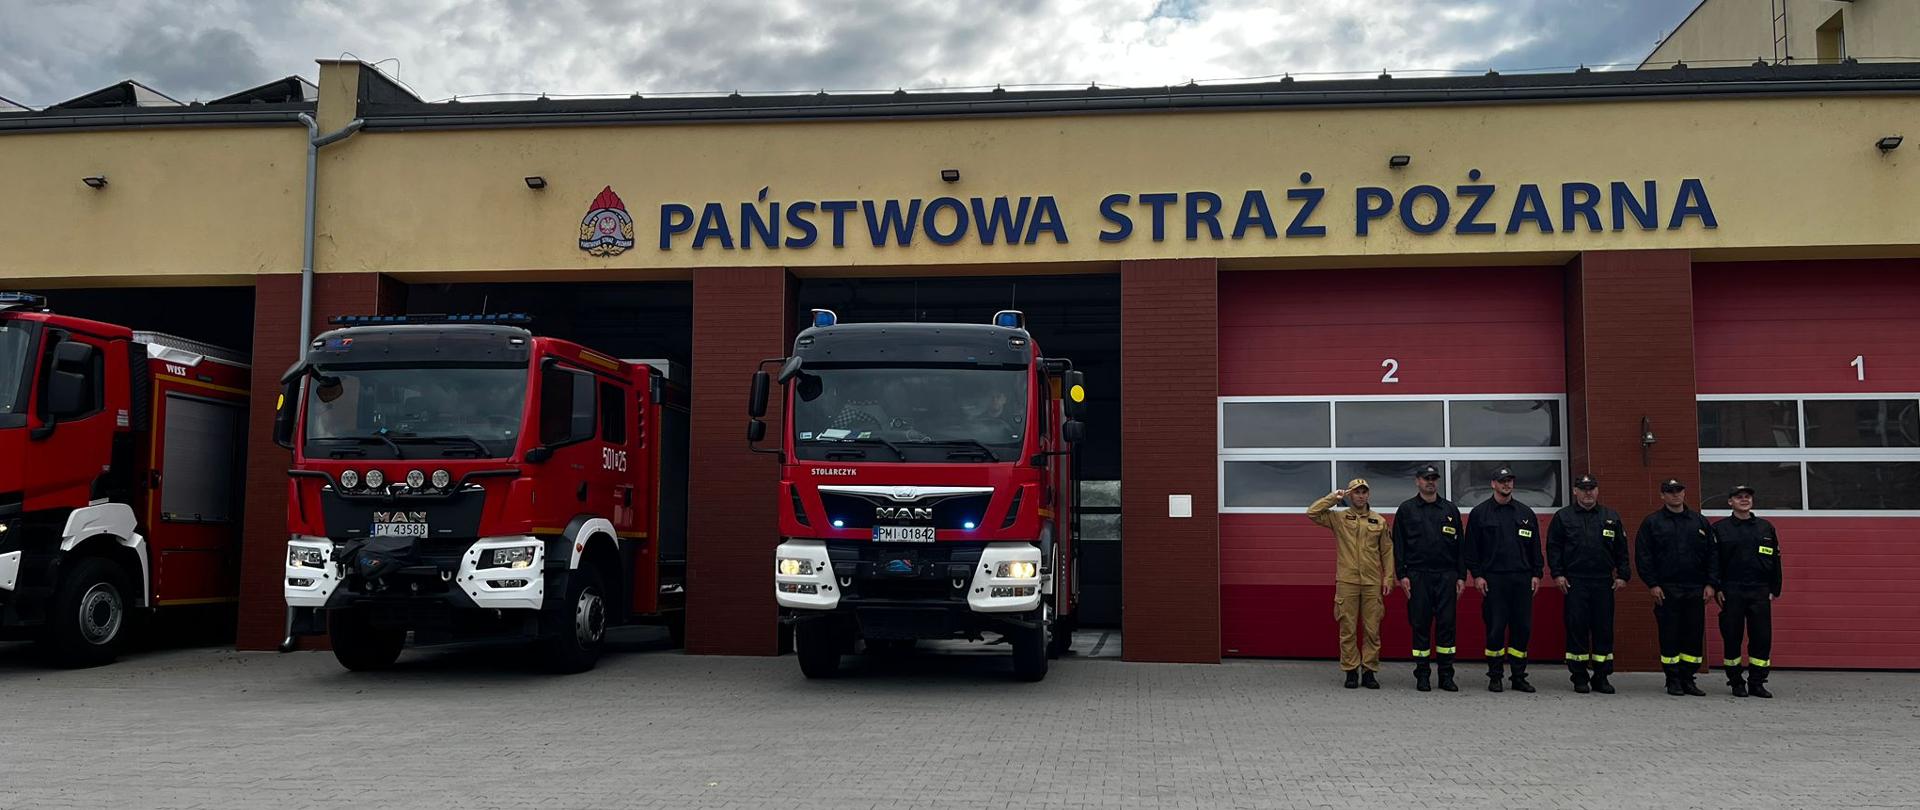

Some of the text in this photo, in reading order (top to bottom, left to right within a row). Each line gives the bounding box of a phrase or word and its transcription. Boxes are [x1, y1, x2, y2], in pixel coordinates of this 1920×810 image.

[659, 169, 1718, 250] PAŃSTWOWA STRAŻ POŻARNA
[166, 364, 186, 376] WISS
[1381, 358, 1398, 382] 2
[1850, 355, 1864, 380] 1
[811, 468, 857, 476] STOLARCZYK
[374, 512, 427, 522] MAN
[876, 507, 932, 519] MAN
[376, 524, 389, 535] PY
[880, 528, 934, 540] PMI 01842
